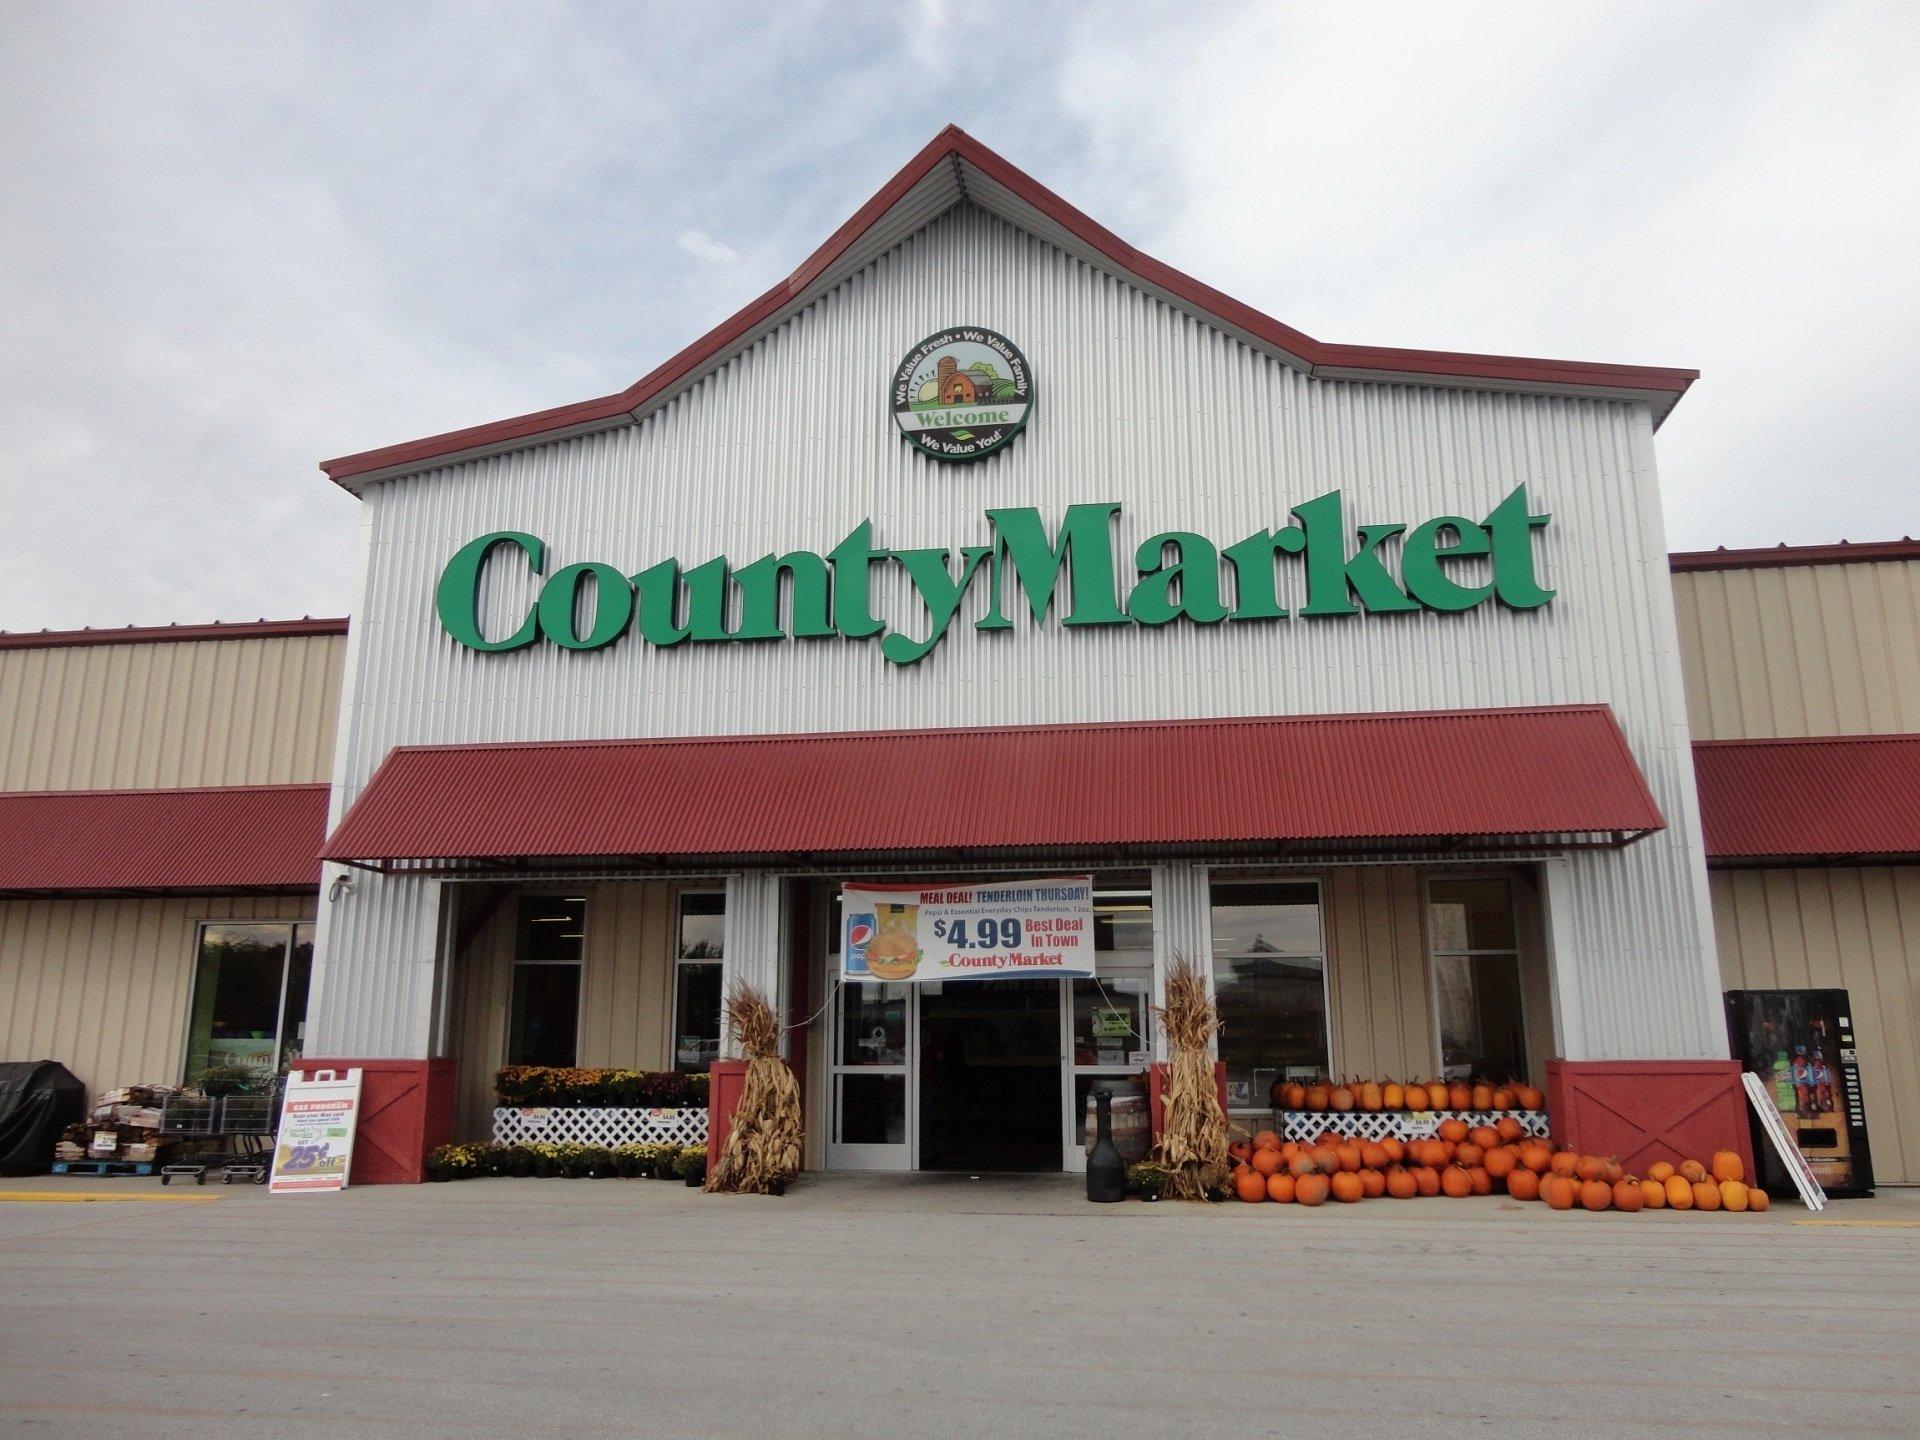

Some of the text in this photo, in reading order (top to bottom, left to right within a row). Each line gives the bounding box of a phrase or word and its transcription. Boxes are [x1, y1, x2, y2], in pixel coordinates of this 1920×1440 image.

[896, 331, 1028, 405] We Value Fresh We Value Family
[915, 410, 1009, 427] Welcome
[921, 433, 940, 450] We
[942, 442, 976, 453] Value
[920, 886, 1089, 904] MEAL DEAL! TENDERLOIN THURSDAY!
[924, 909, 943, 917] Pepsi
[950, 907, 980, 915] Essential
[981, 906, 1012, 915] Everyday
[1013, 905, 1033, 914] Chips
[1025, 917, 1083, 932] Best Deal
[934, 918, 1022, 949] $4.99
[1031, 933, 1079, 948] In Town
[851, 953, 866, 961] pep
[293, 1104, 310, 1112] GAS
[319, 1156, 337, 1168] off
